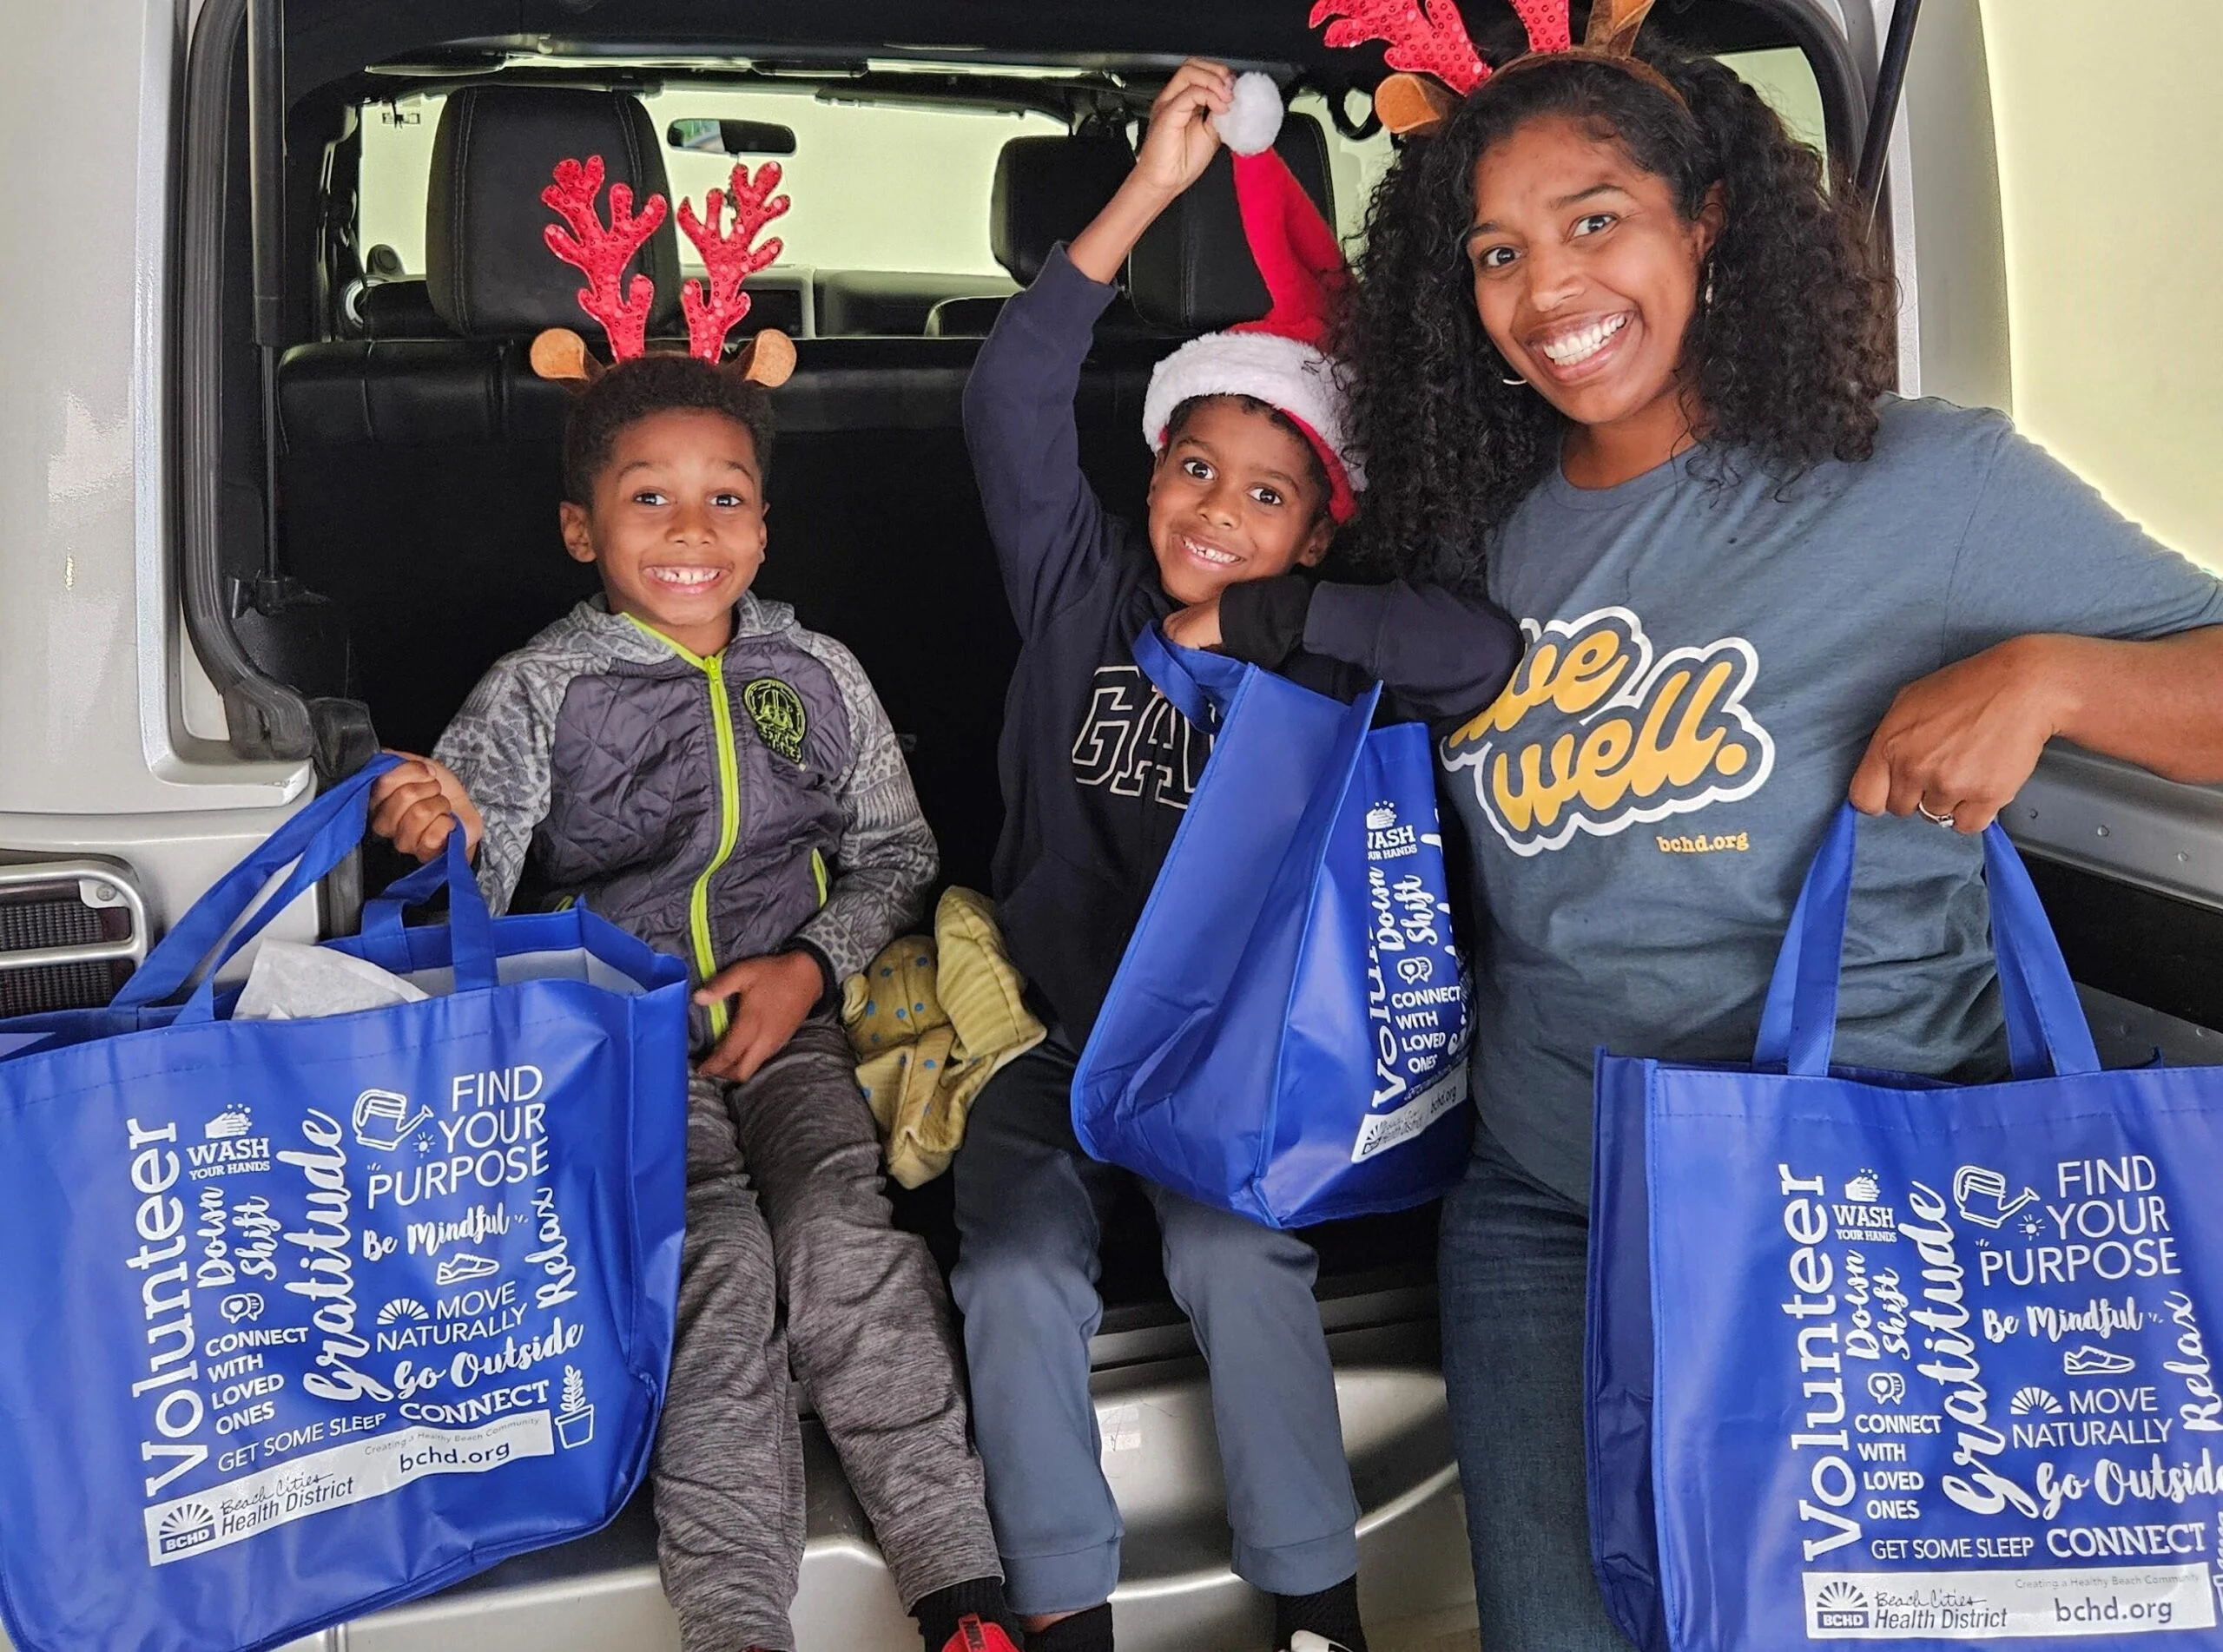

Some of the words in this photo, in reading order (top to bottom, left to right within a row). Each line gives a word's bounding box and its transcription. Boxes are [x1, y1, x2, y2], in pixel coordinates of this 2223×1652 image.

[1449, 630, 1629, 748] ve
[1072, 665, 1217, 810] GA
[1493, 661, 1747, 832] well.
[1382, 844, 1418, 860] HANDS
[1657, 832, 1749, 853] bchd.org
[1369, 866, 1406, 951] Down
[1392, 874, 1438, 945] Shift
[1391, 985, 1461, 1010] CONNECT
[1395, 1010, 1439, 1030] WITH
[1402, 1031, 1446, 1053] LOVED
[1408, 1054, 1438, 1074] ONES
[452, 1064, 543, 1112] FIND
[438, 1103, 546, 1153] YOUR
[187, 1138, 270, 1168] WASH
[188, 1166, 226, 1181] YOUR
[228, 1160, 271, 1175] HANDS
[367, 1136, 550, 1209] PURPOSE
[2058, 1155, 2157, 1198] FIND
[362, 1229, 399, 1261] Be
[406, 1201, 511, 1256] Mindful
[1831, 1204, 1896, 1228] WASH
[1835, 1228, 1864, 1241] YOUR
[1865, 1229, 1897, 1242] HANDS
[2045, 1195, 2171, 1240] YOUR
[196, 1186, 236, 1289] Down
[232, 1195, 282, 1281] Shift
[276, 1108, 395, 1403] Gratitude
[524, 1187, 578, 1309] Relax
[1979, 1237, 2182, 1287] PURPOSE
[126, 1117, 208, 1497] Volunteer
[436, 1280, 517, 1320] MOVE
[1844, 1249, 1880, 1360] Down
[1872, 1267, 1910, 1360] Shift
[1982, 1308, 2020, 1343] Be
[2026, 1297, 2143, 1343] Mindful
[204, 1327, 308, 1357] CONNECT
[376, 1302, 528, 1353] NATURALLY
[208, 1353, 264, 1383] WITH
[393, 1360, 447, 1399] Go
[450, 1316, 584, 1388] Outside
[1778, 1163, 1863, 1562] Volunteer
[1897, 1181, 2040, 1519] Gratitude
[2163, 1291, 2223, 1432] Relax
[211, 1373, 285, 1410] LOVED
[399, 1379, 550, 1424] CONNECT
[2068, 1386, 2159, 1415] MOVE
[215, 1401, 275, 1435] ONES
[364, 1438, 406, 1456] Creating
[417, 1432, 452, 1444] Healthy
[454, 1433, 484, 1443] Beach
[485, 1418, 540, 1438] Community
[1854, 1414, 1943, 1434] CONNECT
[2012, 1418, 2173, 1449] NATURALLY
[217, 1442, 260, 1472] GET
[264, 1421, 325, 1457] SOME
[329, 1412, 387, 1437] SLEEP
[400, 1442, 511, 1473] bchd.org
[1857, 1443, 1906, 1462] WITH
[220, 1485, 274, 1516] Beach
[276, 1473, 334, 1498] Cities
[1863, 1471, 1924, 1491] LOVED
[2036, 1462, 2090, 1520] Go
[221, 1501, 280, 1537] Health
[285, 1477, 354, 1513] District
[1866, 1500, 1921, 1519] ONES
[165, 1528, 210, 1552] BCHD
[1871, 1540, 1909, 1560] GET
[1913, 1538, 1973, 1559] SOME
[1976, 1537, 2035, 1558] SLEEP
[2046, 1523, 2206, 1558] CONNECT
[1875, 1589, 1929, 1607] Beach
[1930, 1588, 1987, 1607] Cities
[2014, 1578, 2059, 1589] Creating
[2070, 1576, 2108, 1589] Healthy
[2112, 1576, 2141, 1586] Beach
[2144, 1573, 2200, 1584] Community
[1823, 1613, 1864, 1627] BCHD
[1875, 1609, 1935, 1629] Health
[1941, 1607, 2008, 1629] District
[2054, 1596, 2173, 1624] bchd.org
